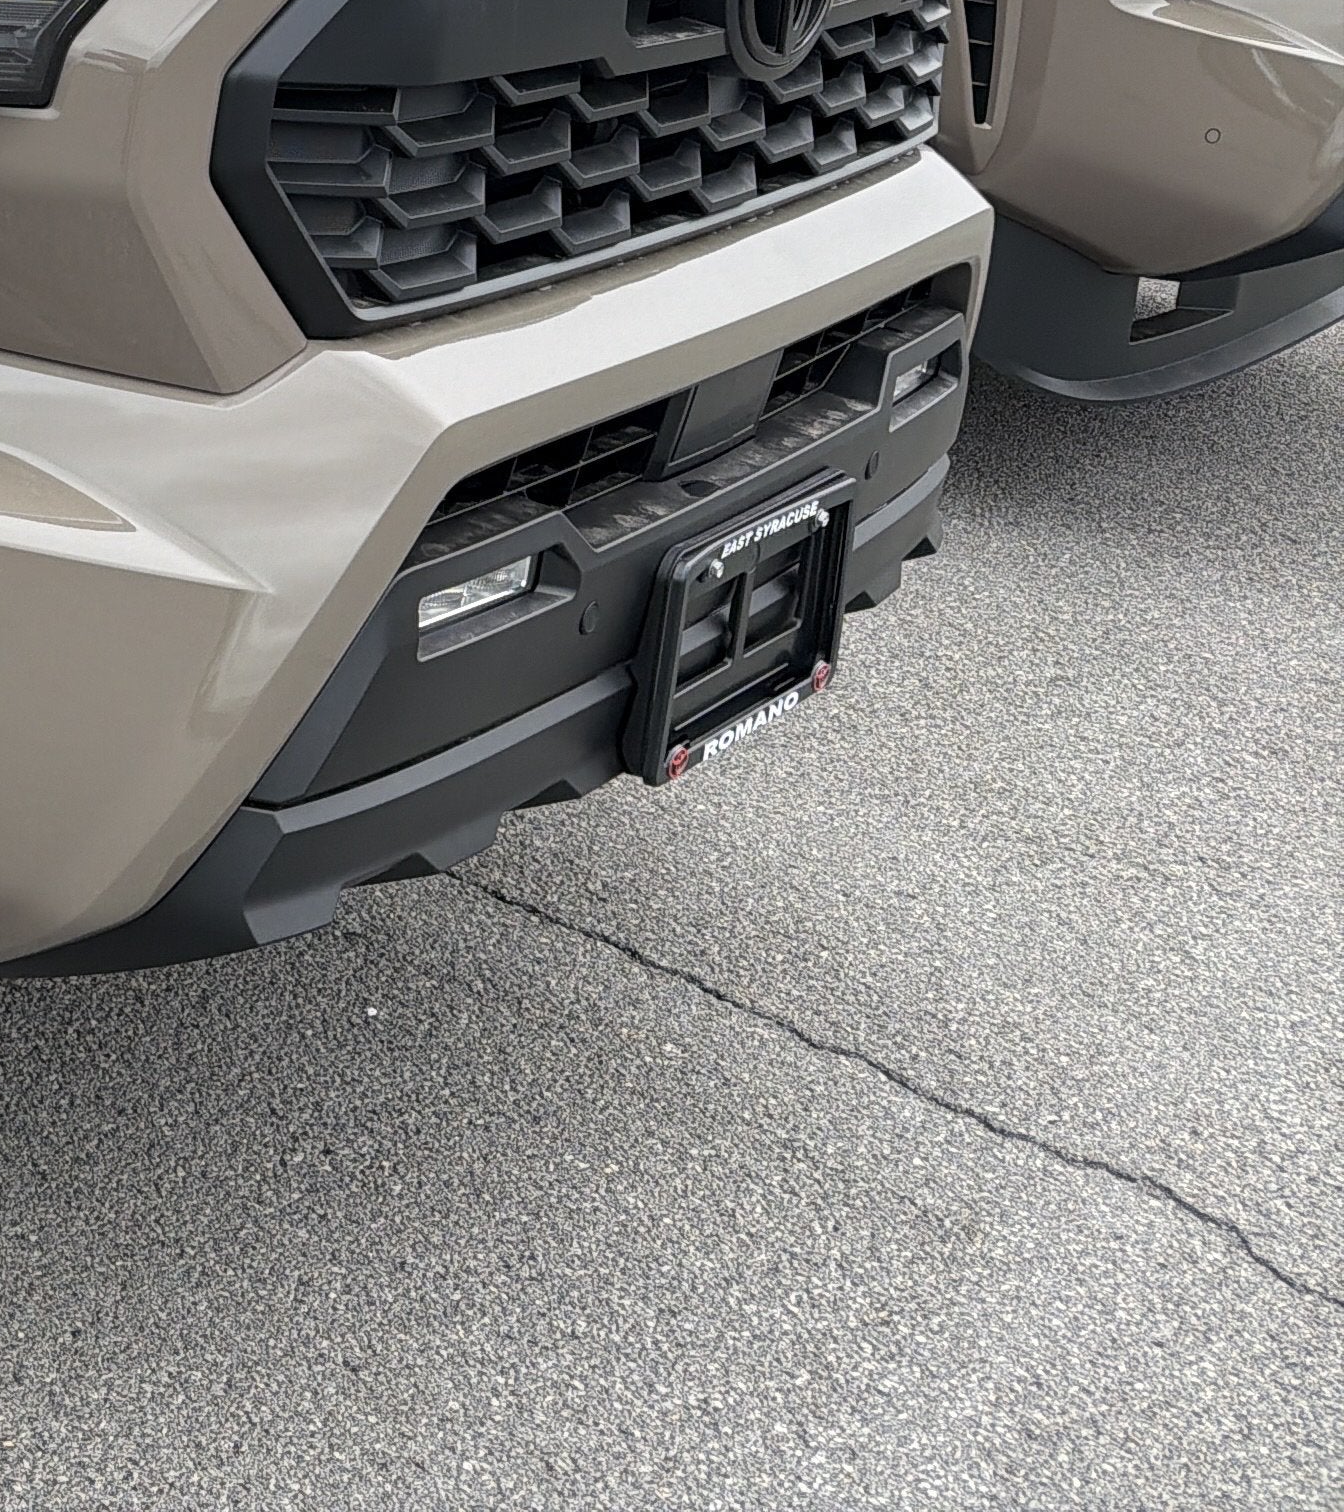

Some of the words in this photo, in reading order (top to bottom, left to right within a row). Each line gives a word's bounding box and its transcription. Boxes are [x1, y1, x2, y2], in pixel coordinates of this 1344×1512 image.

[721, 530, 754, 559] EAST
[753, 500, 819, 542] SYRACUSE
[702, 690, 800, 762] ROMANO
